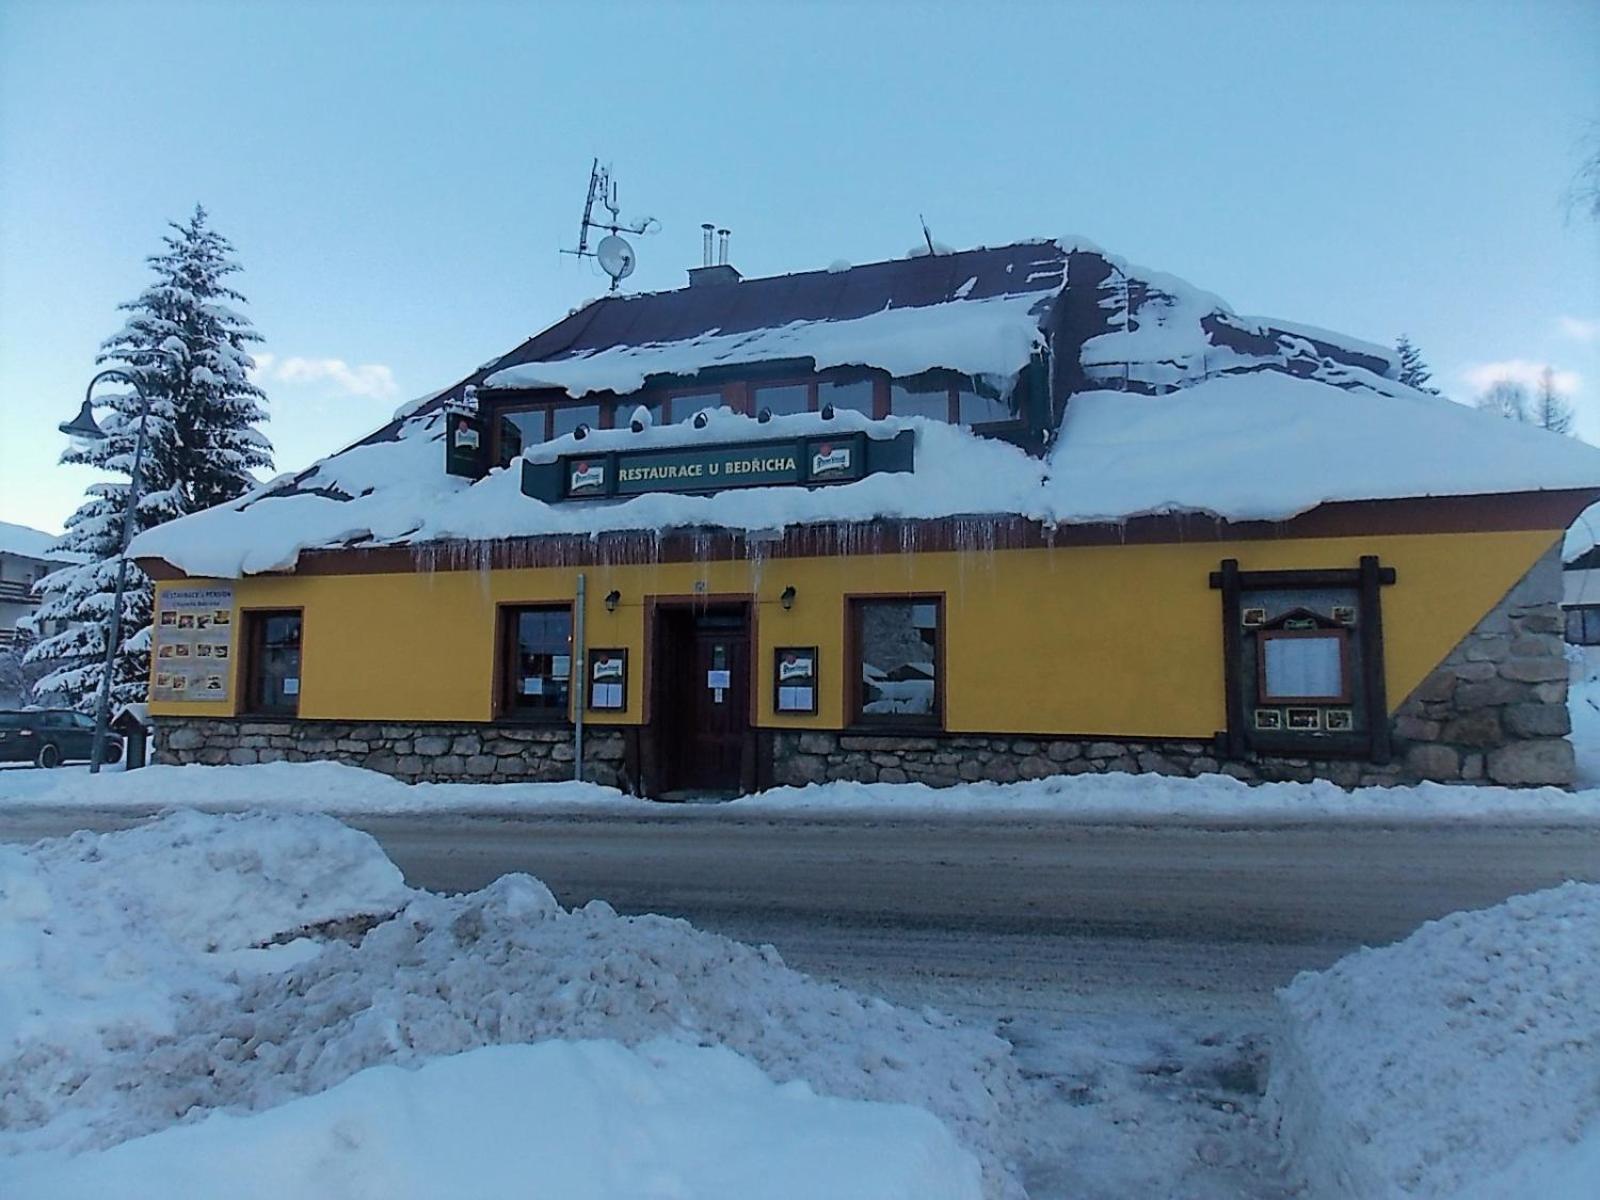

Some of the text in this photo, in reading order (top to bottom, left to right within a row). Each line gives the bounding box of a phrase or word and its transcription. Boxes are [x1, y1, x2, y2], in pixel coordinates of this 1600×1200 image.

[618, 464, 703, 482] RESTAURACE
[708, 463, 720, 476] U
[725, 457, 797, 475] BEDŘICHA
